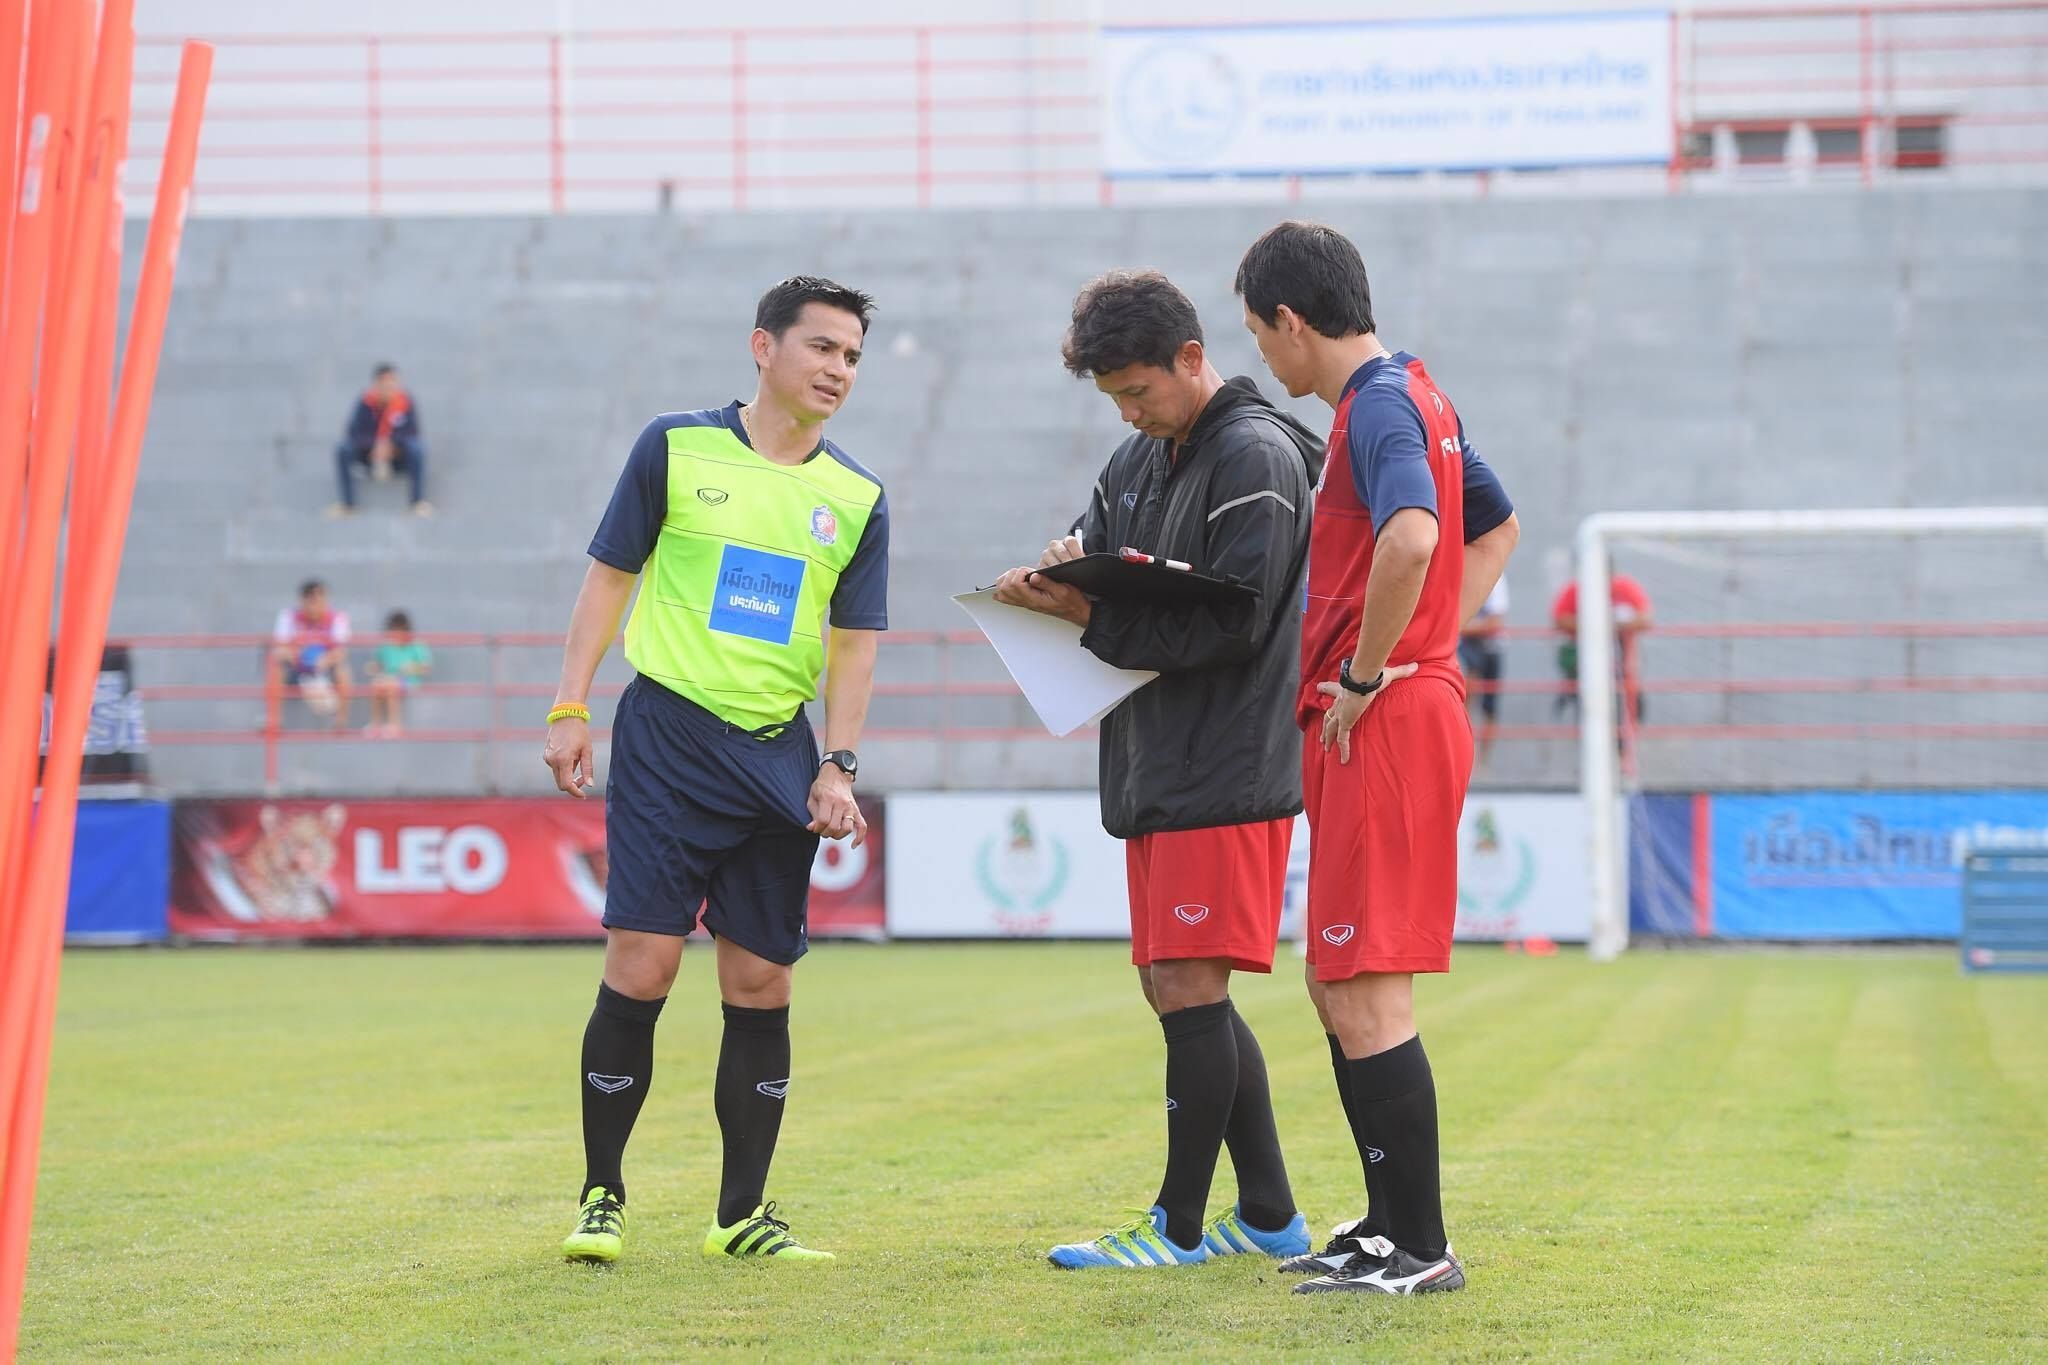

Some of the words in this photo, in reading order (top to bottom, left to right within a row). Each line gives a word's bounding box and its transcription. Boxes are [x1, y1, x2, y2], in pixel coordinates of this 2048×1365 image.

[721, 566, 795, 600] เมืองไทย
[729, 595, 781, 615] ประกันภัย
[354, 824, 509, 895] LEO
[1744, 812, 1953, 869] เมืองไทย
